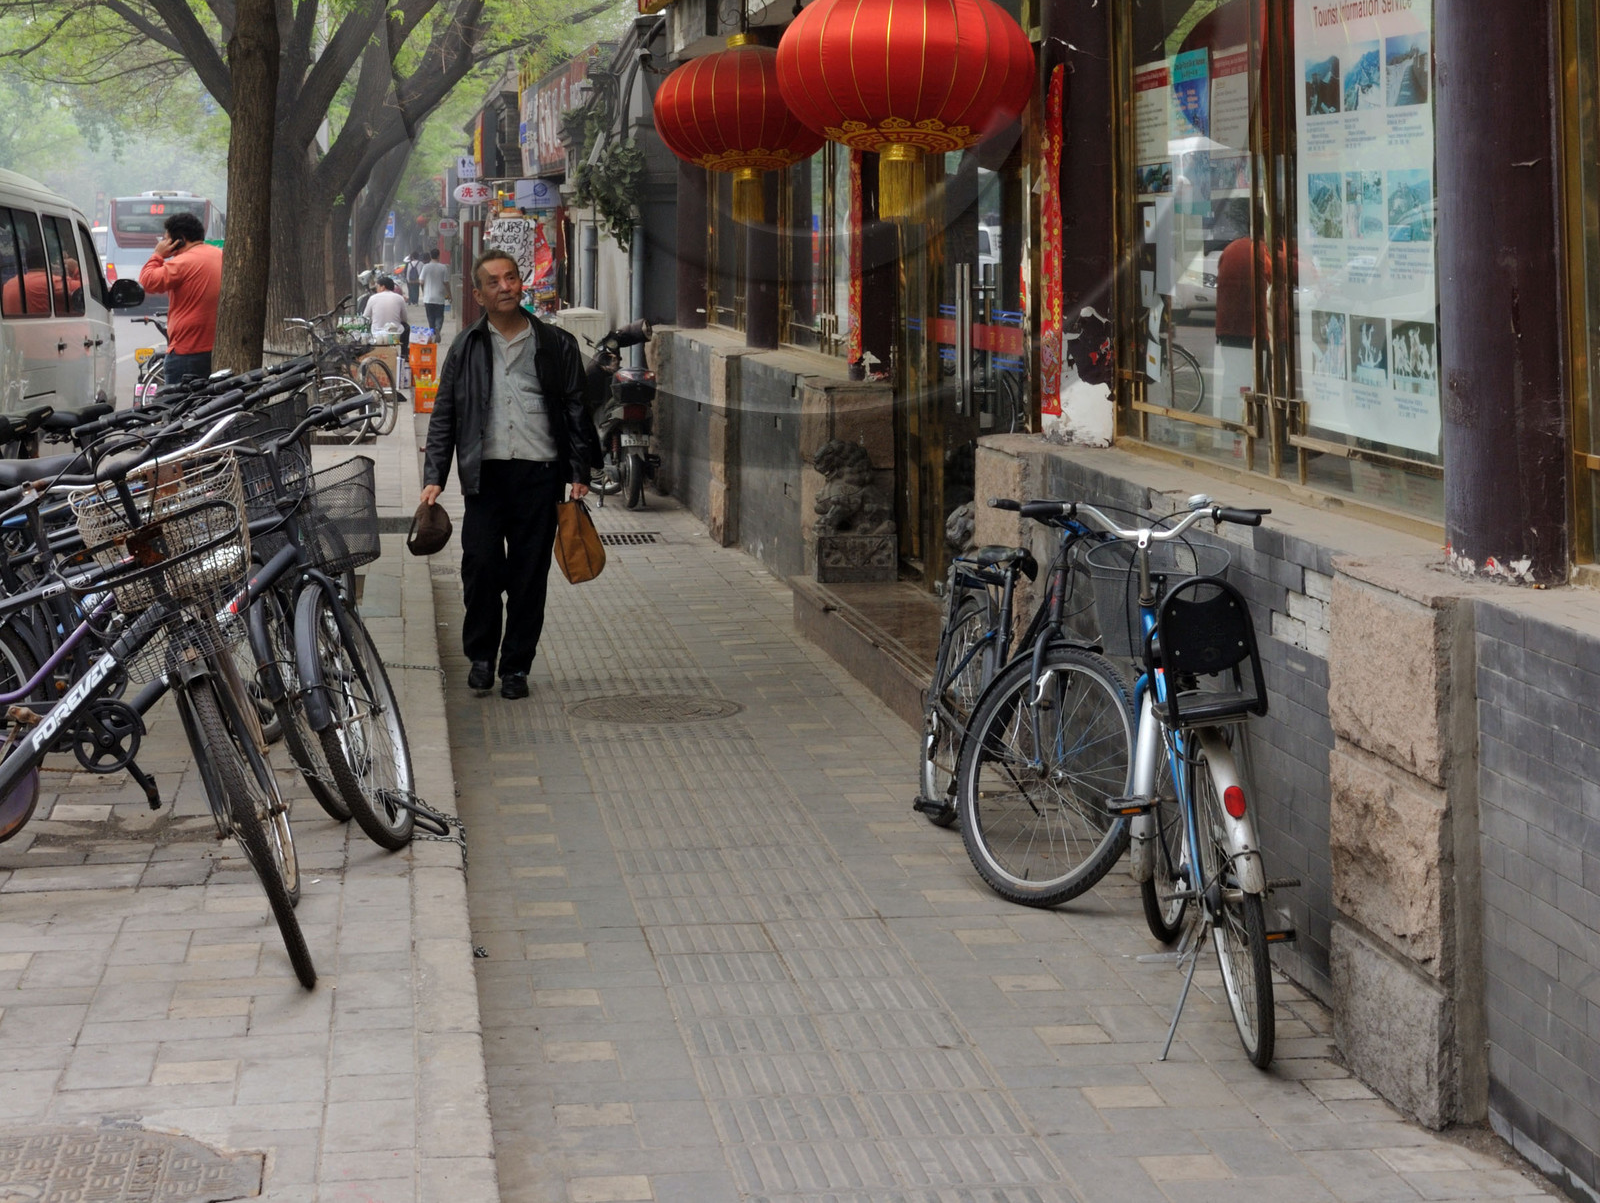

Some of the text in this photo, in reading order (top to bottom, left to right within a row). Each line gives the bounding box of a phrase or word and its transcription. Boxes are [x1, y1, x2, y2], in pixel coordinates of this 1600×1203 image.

[1313, 0, 1339, 27] Tourist
[461, 186, 489, 198] 洗衣
[150, 204, 165, 215] 60
[31, 653, 118, 753] FOREVER
